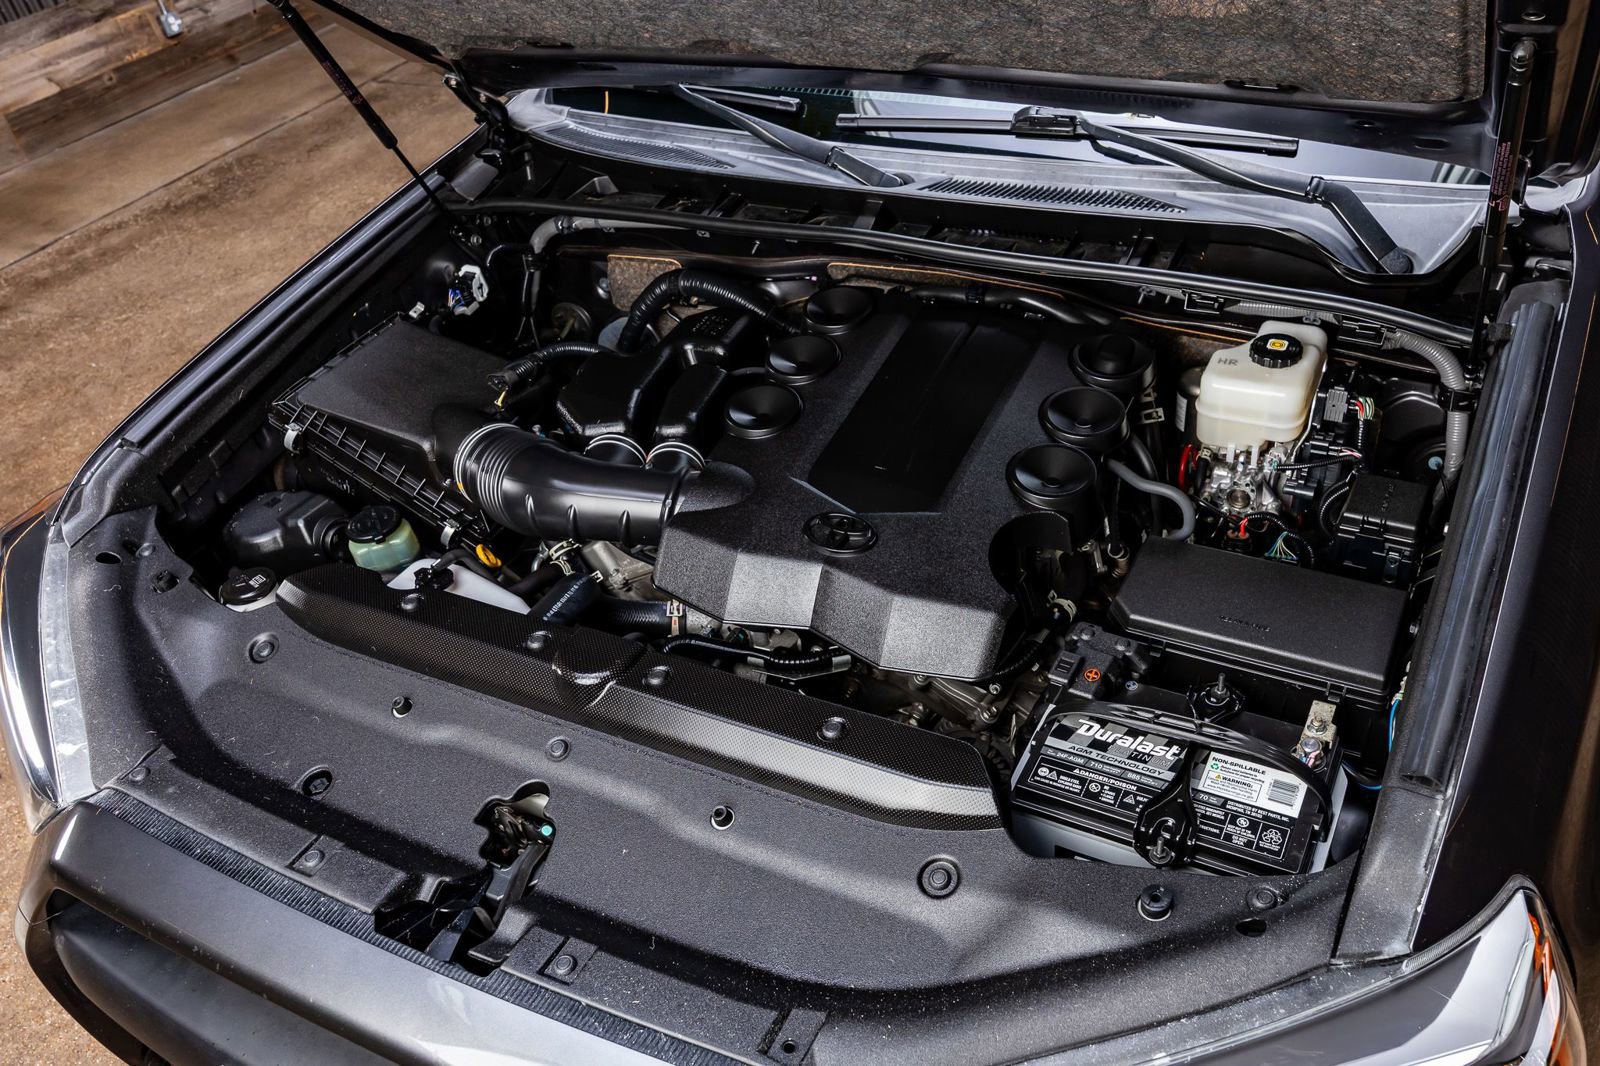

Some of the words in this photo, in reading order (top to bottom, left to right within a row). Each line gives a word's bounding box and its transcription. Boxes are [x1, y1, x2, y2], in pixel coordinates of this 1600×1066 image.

[1217, 357, 1238, 366] HR
[1078, 718, 1181, 760] Duralast
[1068, 746, 1093, 756] AGM
[1096, 752, 1165, 776] TECHNOLOGY
[1212, 756, 1266, 776] NON-SPILLABLE
[1080, 770, 1137, 790] DANGER/POISON
[1222, 776, 1253, 788] WARNING:
